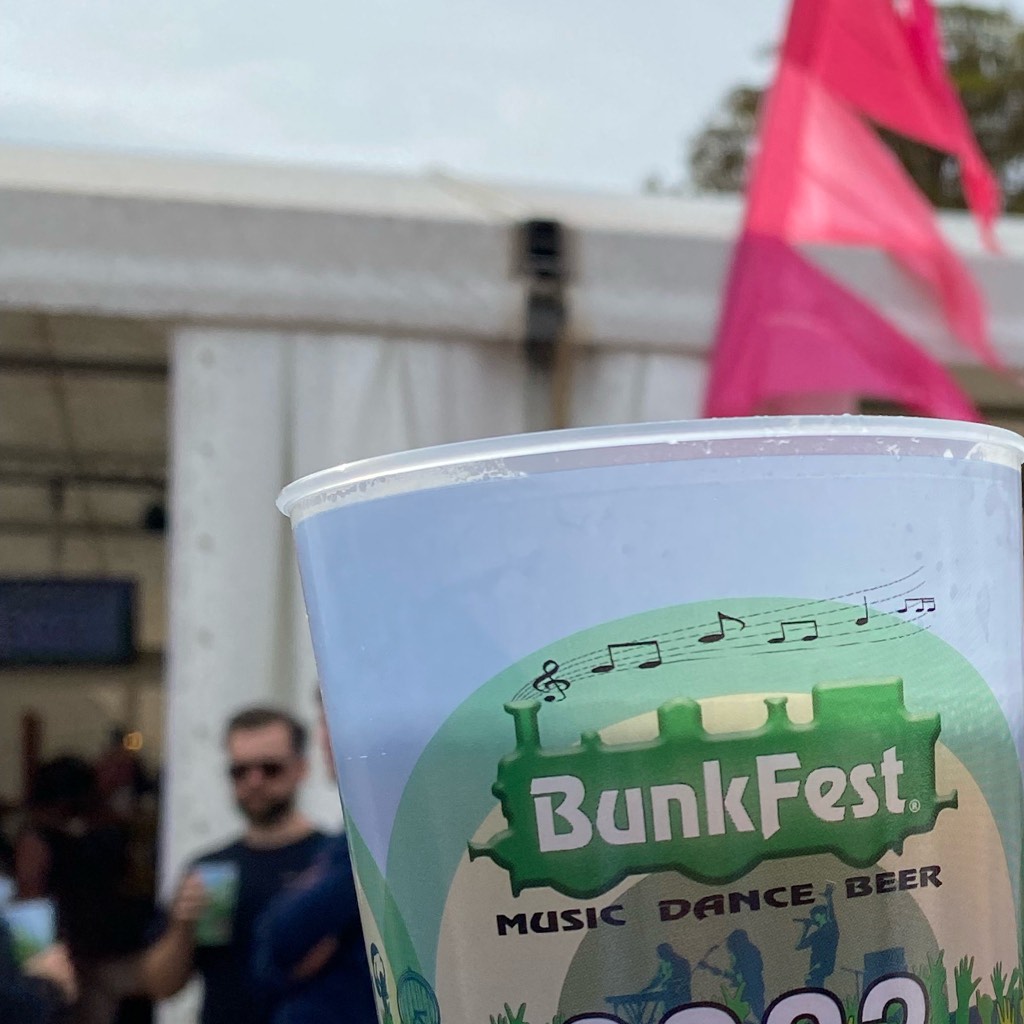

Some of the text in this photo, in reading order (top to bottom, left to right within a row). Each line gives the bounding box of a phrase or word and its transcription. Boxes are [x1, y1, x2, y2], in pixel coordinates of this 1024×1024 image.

[530, 746, 905, 853] BunkFest
[496, 865, 942, 936] MUSIC DANCE BEER
